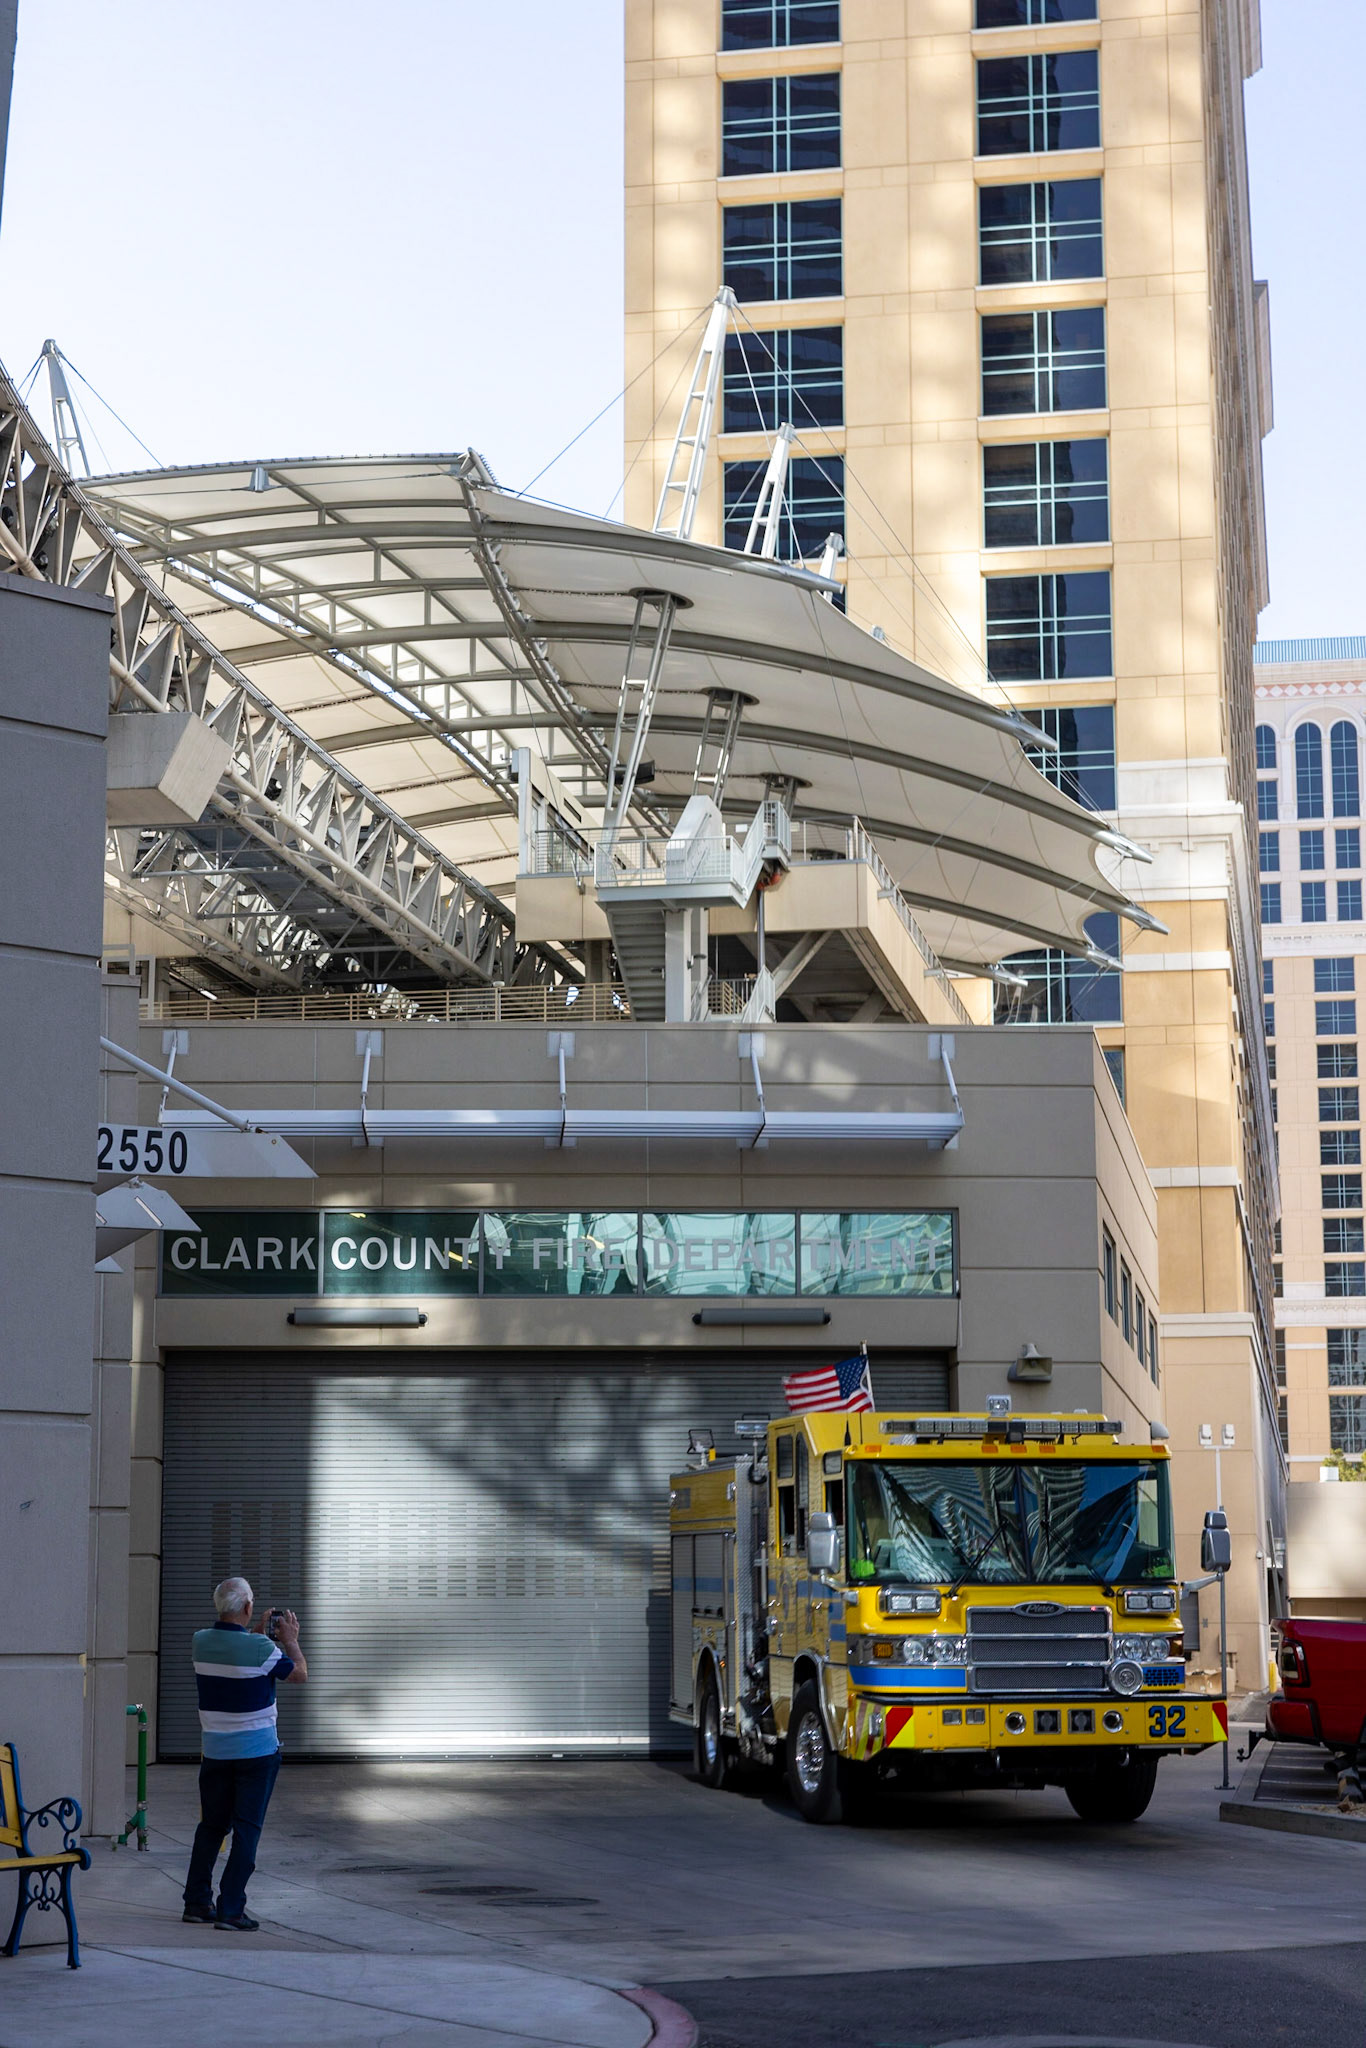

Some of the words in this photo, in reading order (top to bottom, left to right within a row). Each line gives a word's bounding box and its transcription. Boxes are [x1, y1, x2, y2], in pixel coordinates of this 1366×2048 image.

[97, 1127, 188, 1174] 2550
[170, 1236, 317, 1271] CLARK
[330, 1236, 513, 1271] COUNTY
[532, 1237, 627, 1271] FIRE
[652, 1237, 940, 1272] DEPARTMENT
[1148, 1705, 1186, 1737] 32
